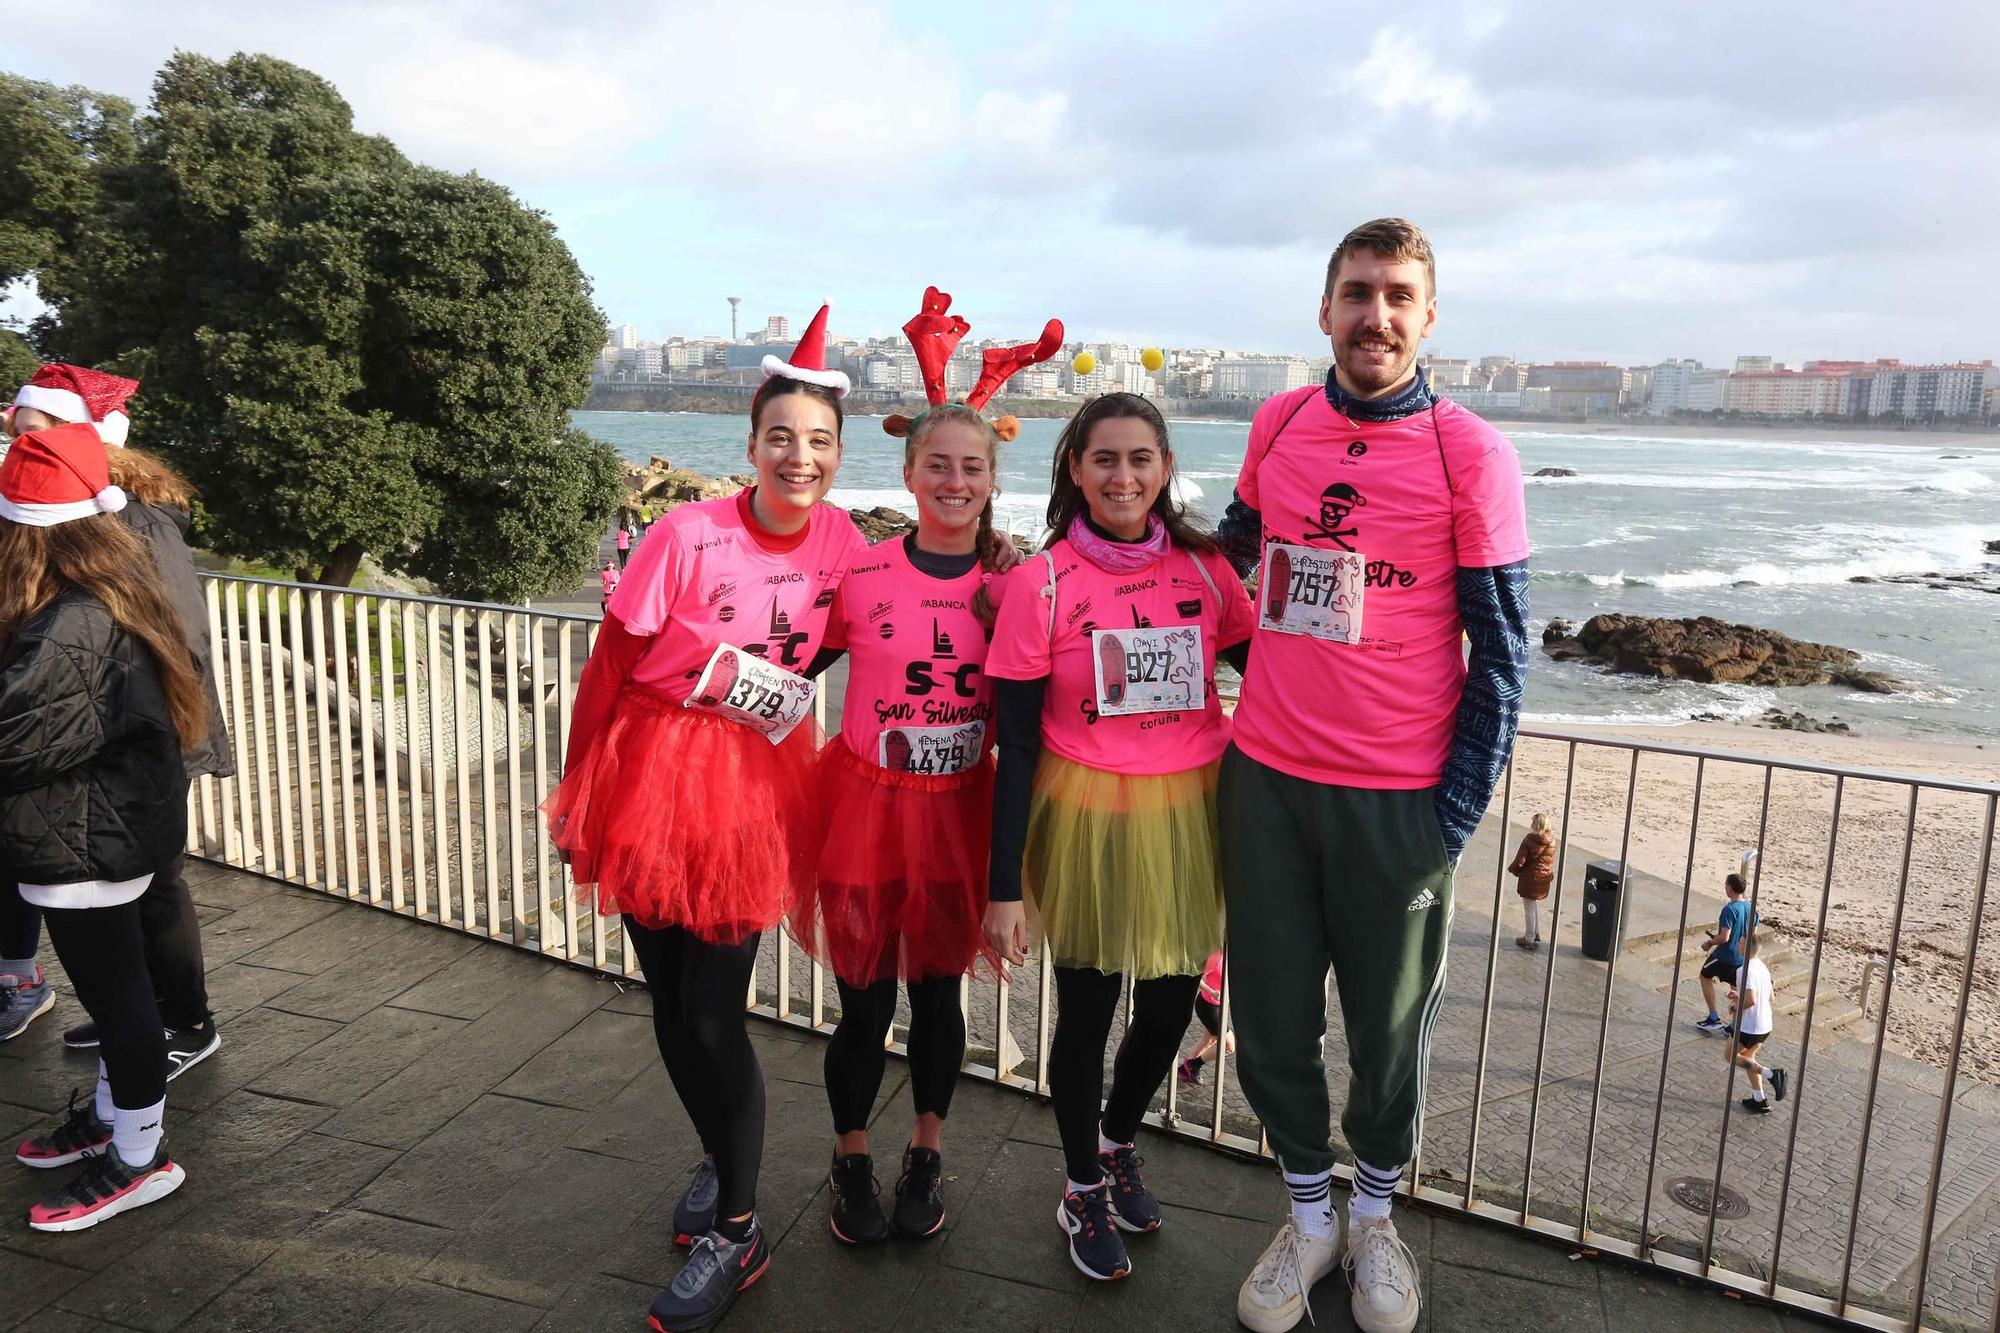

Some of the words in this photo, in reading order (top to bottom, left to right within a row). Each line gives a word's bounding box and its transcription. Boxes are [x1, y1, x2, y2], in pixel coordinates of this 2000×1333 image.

[694, 538, 721, 551] luanvi
[851, 564, 880, 575] luanvi
[1291, 571, 1338, 607] 757
[1136, 639, 1157, 648] JAVI
[1126, 650, 1172, 684] 927
[749, 668, 780, 686] CARMEN
[874, 699, 916, 724] San
[1140, 713, 1180, 730] coruña
[918, 736, 952, 745] HELENA
